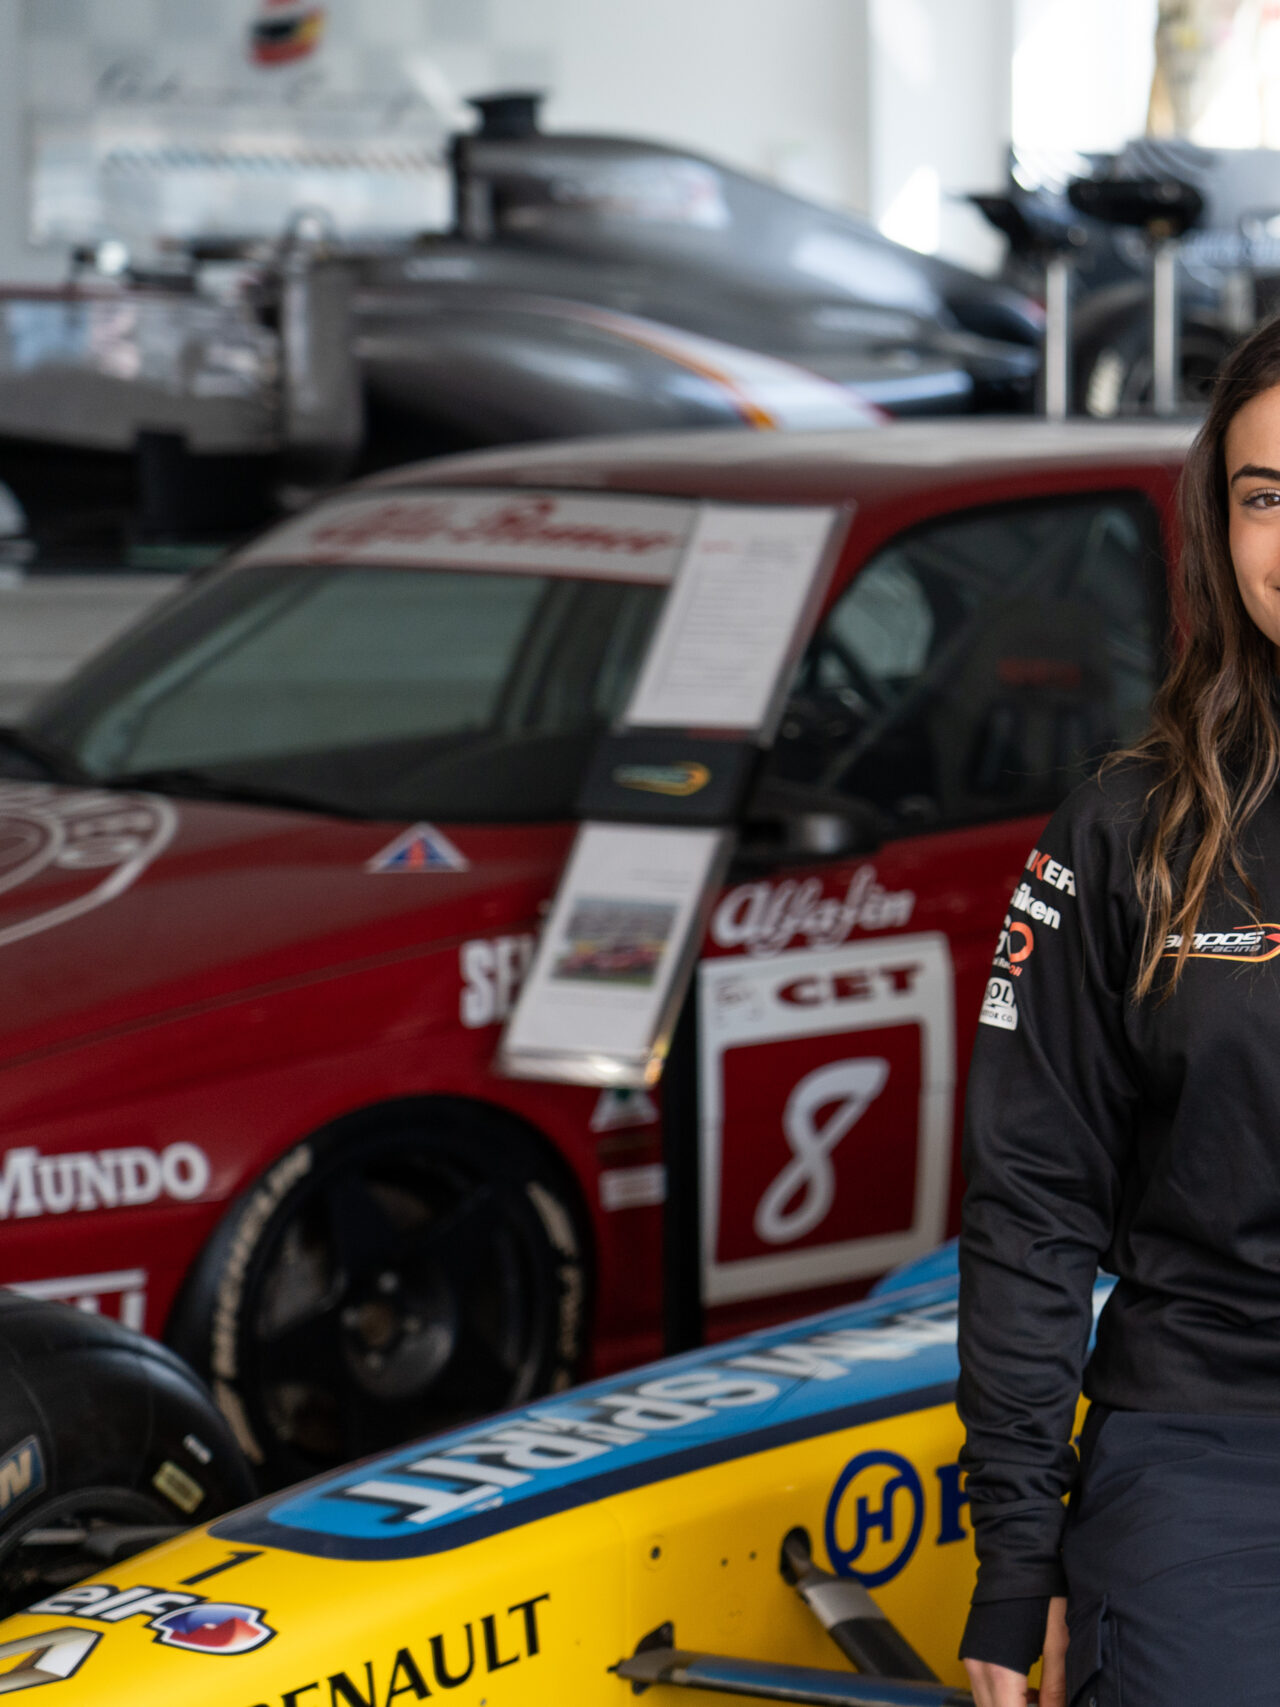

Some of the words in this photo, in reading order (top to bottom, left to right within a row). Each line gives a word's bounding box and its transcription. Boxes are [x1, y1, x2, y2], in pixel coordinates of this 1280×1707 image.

[1024, 849, 1076, 897] KER
[1010, 883, 1061, 930] iken
[1200, 944, 1262, 953] racing
[777, 963, 923, 1009] CET
[753, 1056, 889, 1244] 8
[24, 1583, 205, 1623] elf
